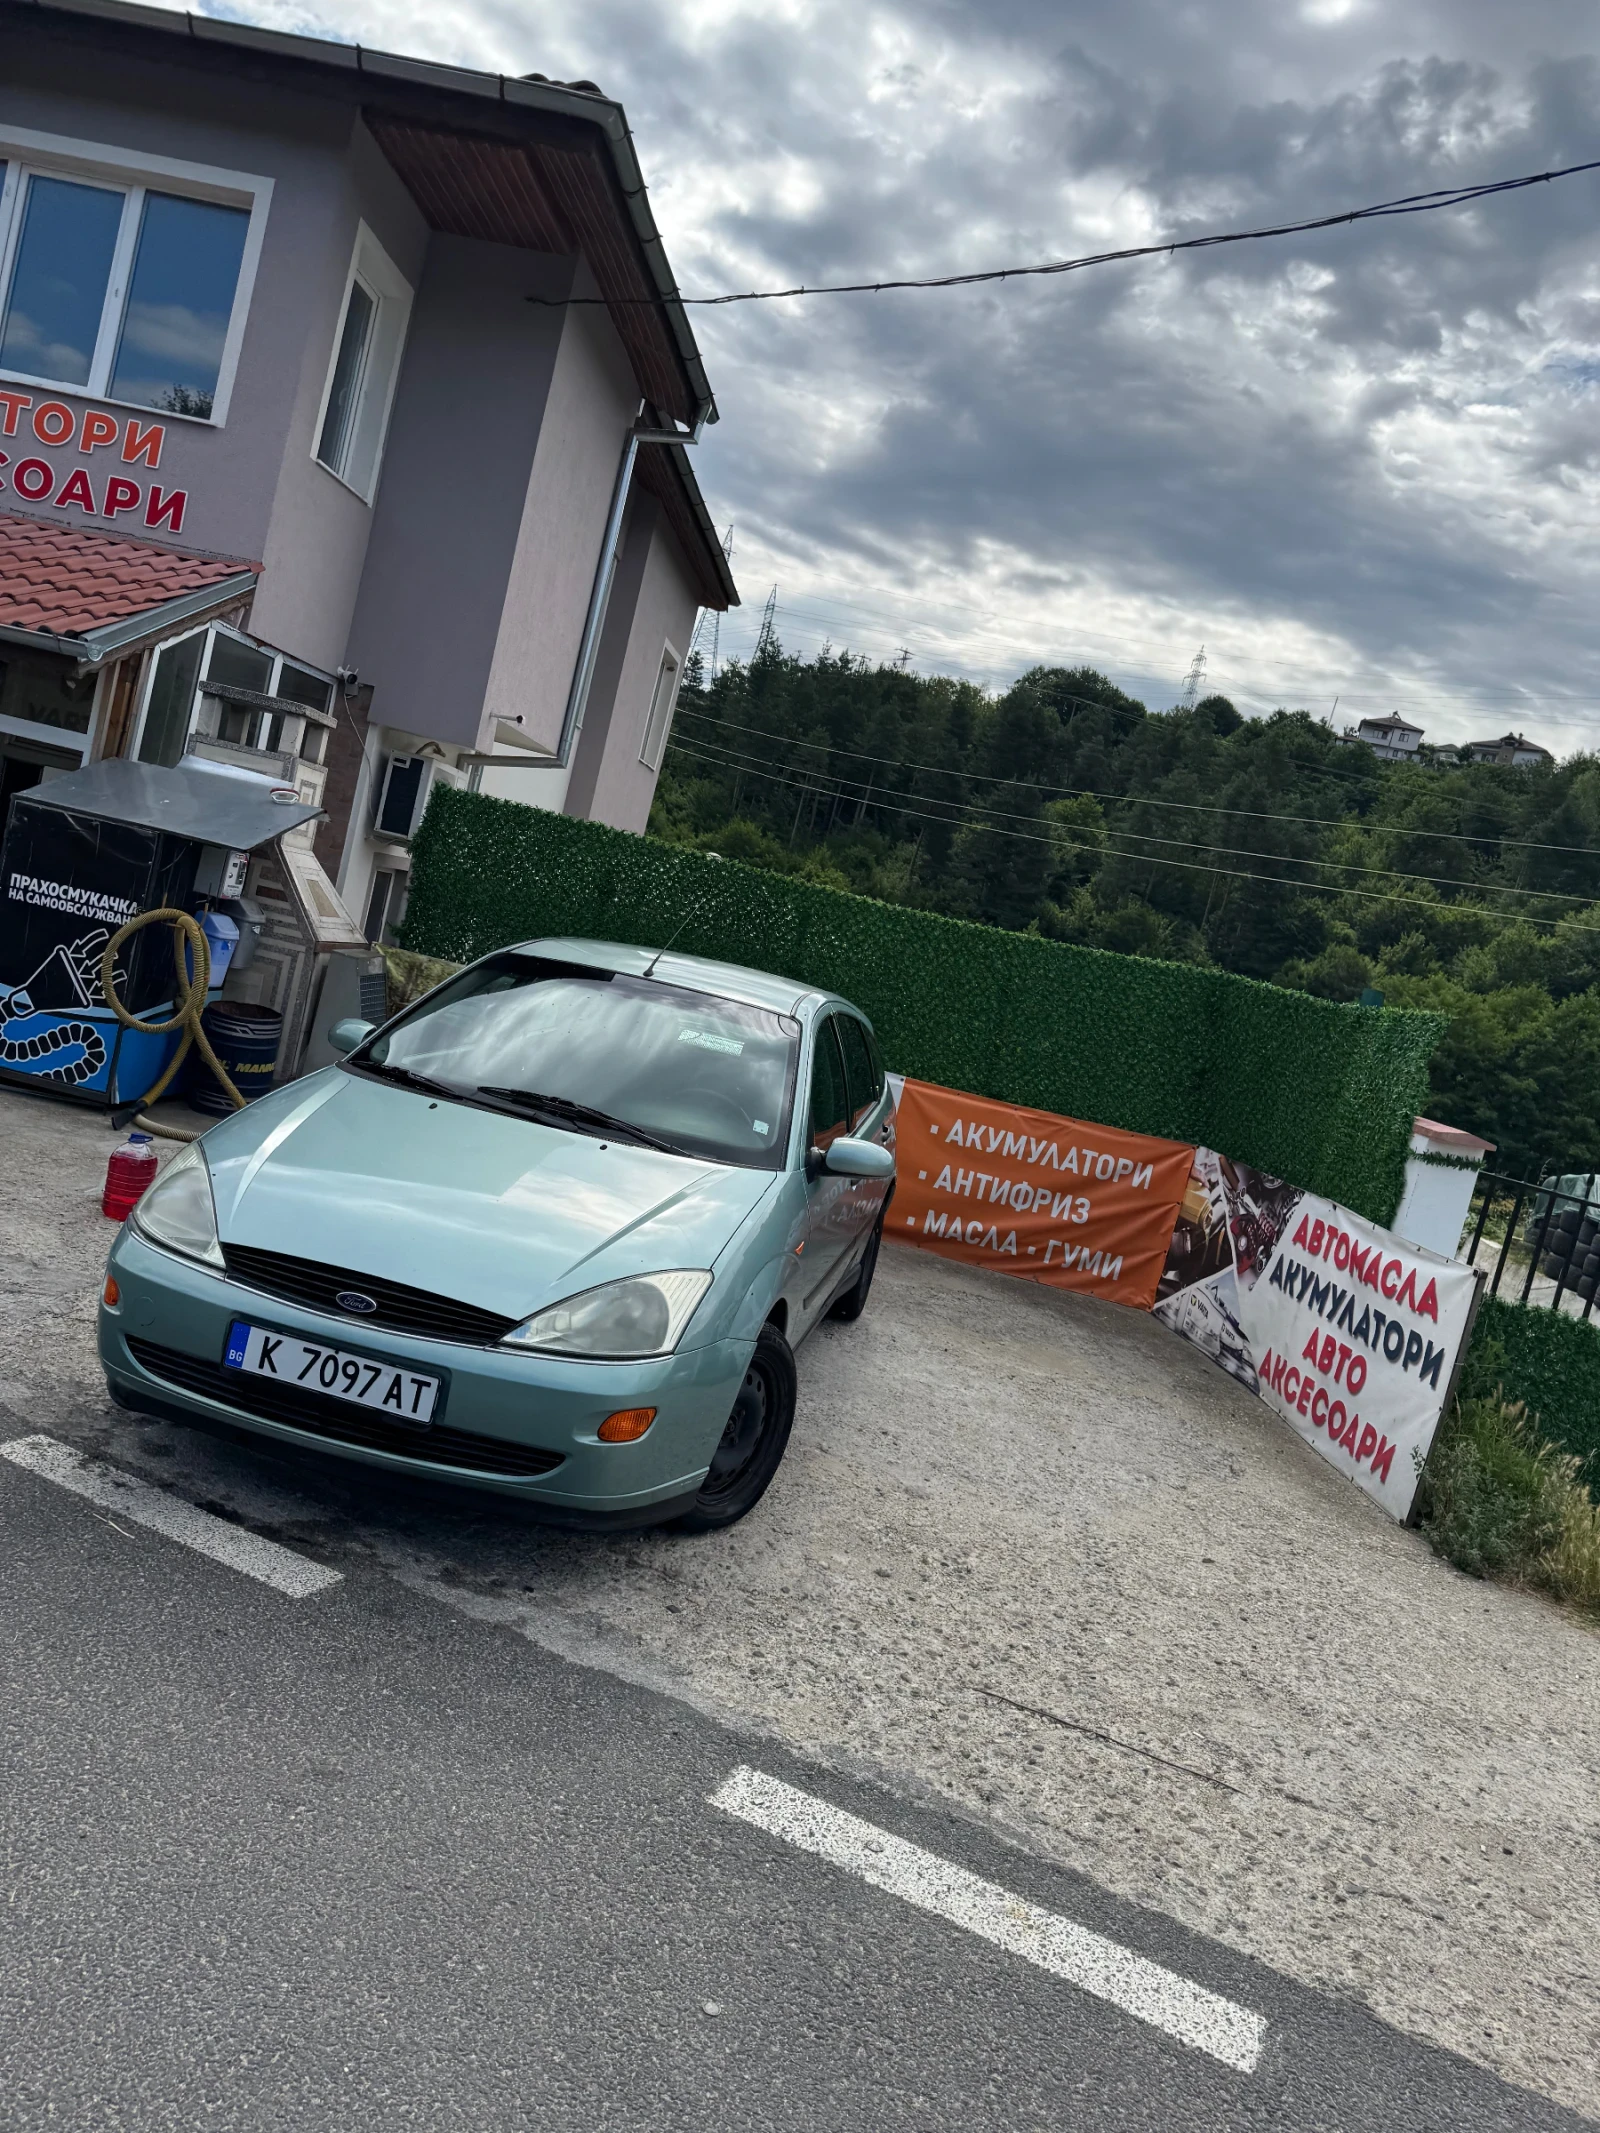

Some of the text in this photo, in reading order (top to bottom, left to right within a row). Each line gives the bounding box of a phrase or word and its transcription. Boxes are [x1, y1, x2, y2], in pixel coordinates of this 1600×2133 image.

[0, 391, 166, 469] ТОРИ
[0, 450, 188, 534] ОАРИ
[8, 887, 136, 926] НА САМООБСЛУЖВАН
[10, 873, 138, 915] ПРАХОСМУКАЧКА
[945, 1118, 1154, 1190] АКУМУЛАТОРИ
[933, 1164, 1091, 1225] АНТИФРИЗ
[923, 1209, 1017, 1256] МАСЛА
[1043, 1239, 1124, 1281] ГУМИ
[1292, 1213, 1440, 1324] АВТОМАСЛА
[229, 1349, 243, 1362] BG
[1269, 1253, 1446, 1391] АКУМУЛАТОРИ
[1302, 1327, 1368, 1396] АВТО
[1258, 1347, 1397, 1485] АКСЕСОАРИ
